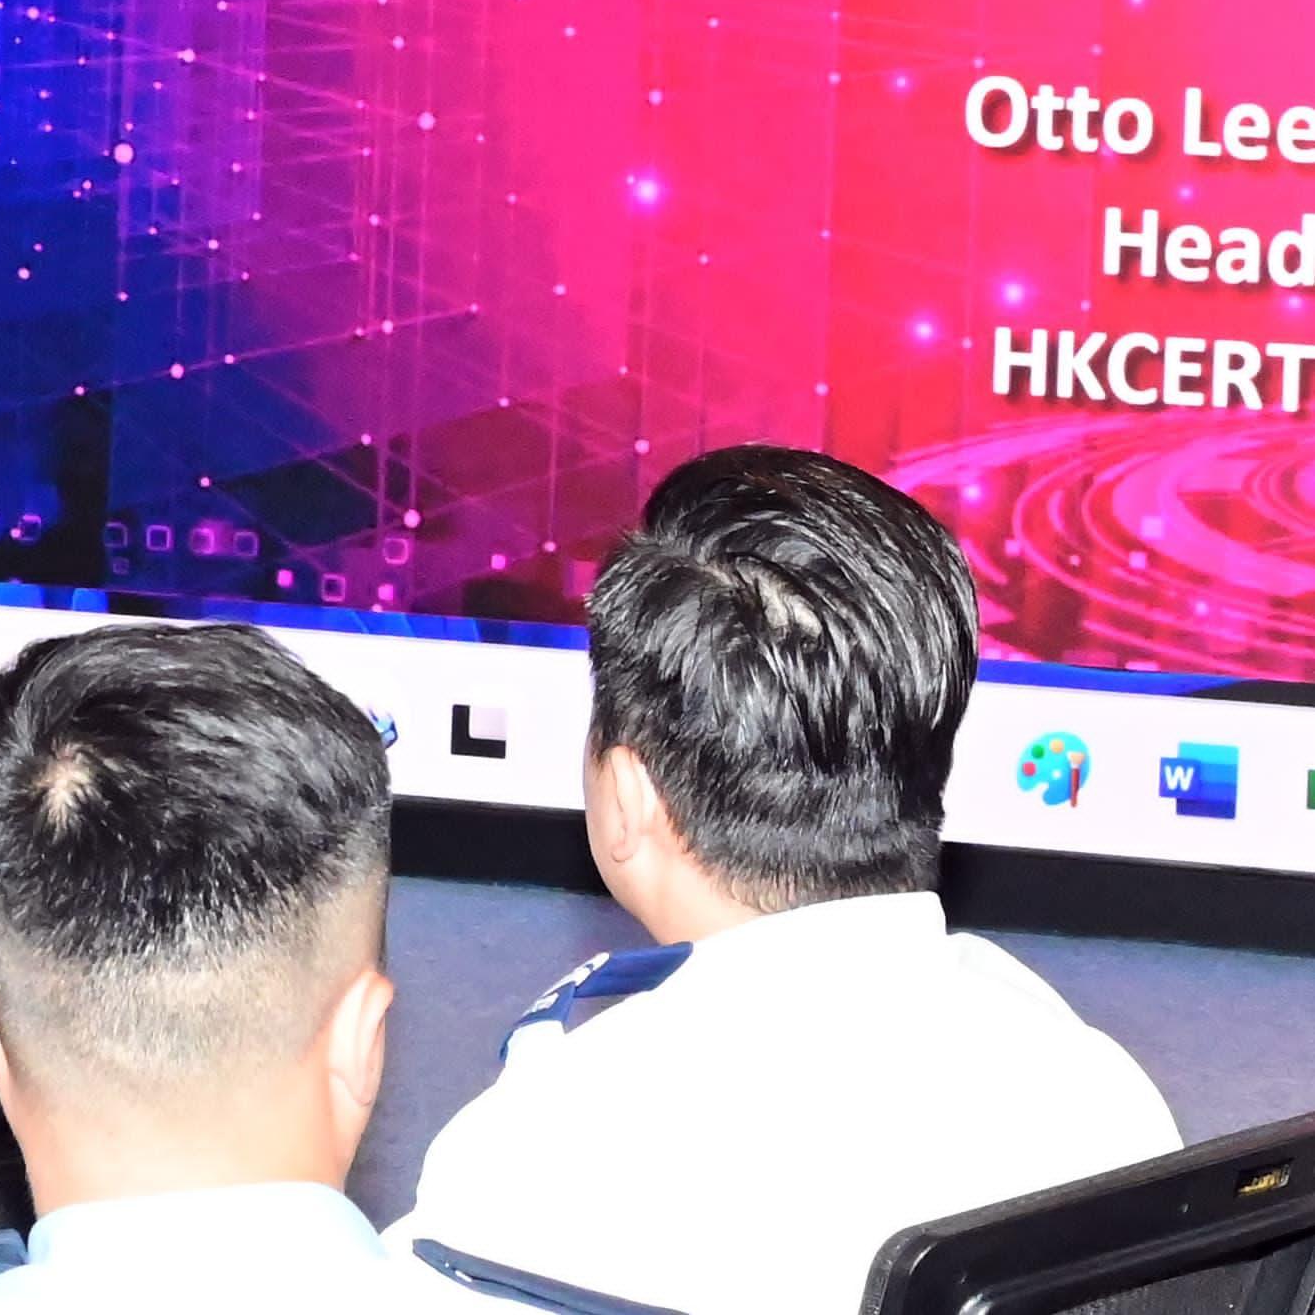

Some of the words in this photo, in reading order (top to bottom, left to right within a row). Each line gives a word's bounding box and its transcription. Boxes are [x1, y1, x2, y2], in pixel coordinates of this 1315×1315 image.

[964, 74, 1154, 155] Otto
[1182, 86, 1315, 164] Lee
[1102, 206, 1315, 288] Head
[992, 326, 1315, 414] HKCERT
[1164, 765, 1195, 792] W
